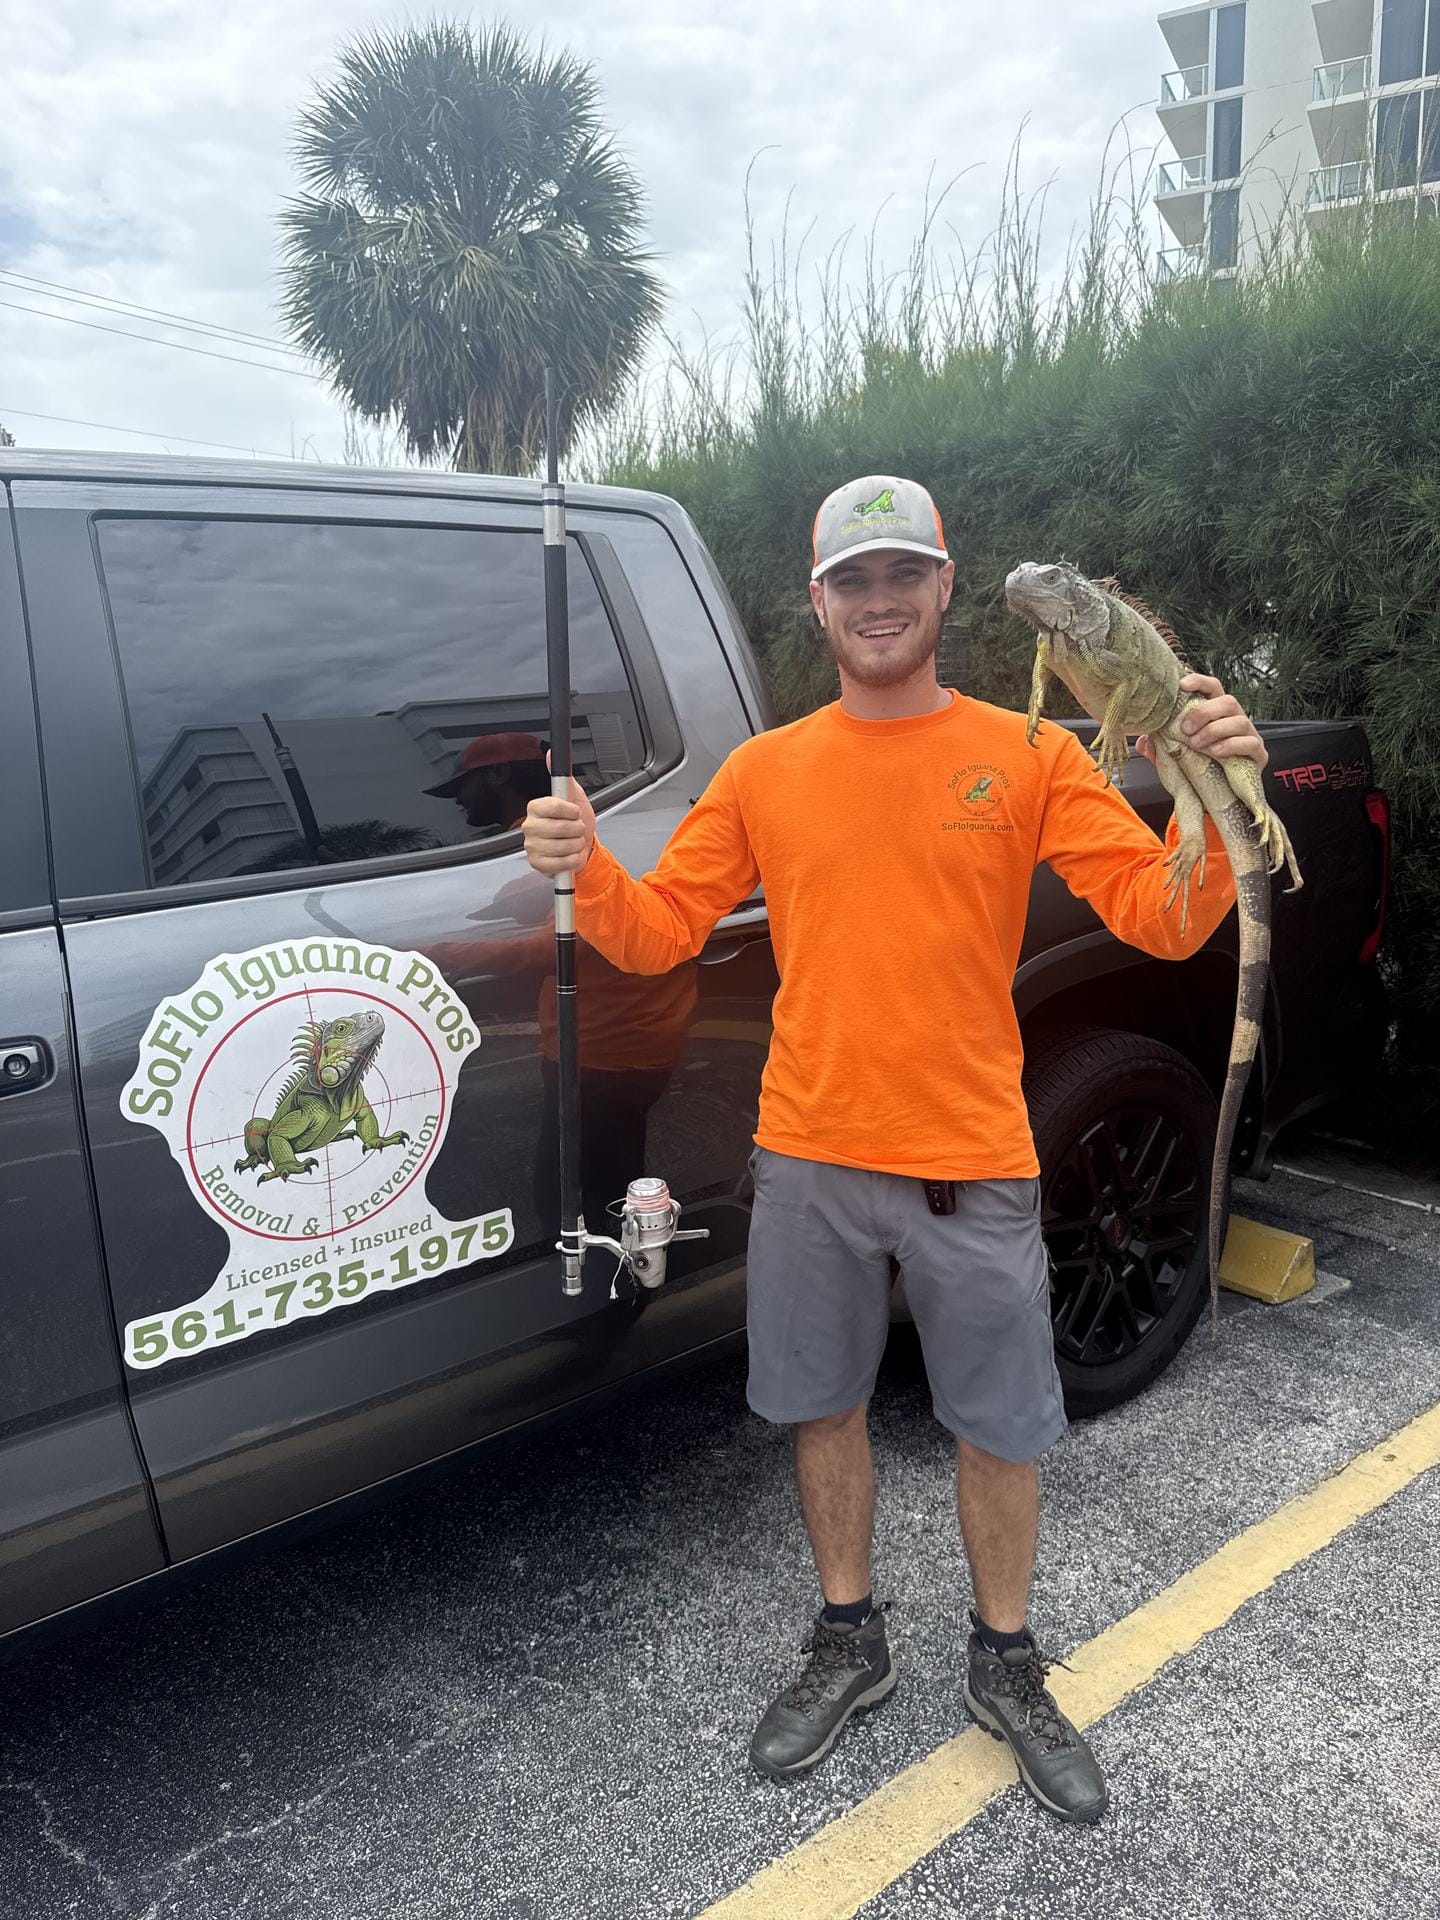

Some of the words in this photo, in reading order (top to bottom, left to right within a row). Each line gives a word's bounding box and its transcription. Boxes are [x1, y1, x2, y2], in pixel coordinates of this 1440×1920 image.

[948, 770, 967, 789] SoFlo
[968, 764, 997, 774] Iguana
[998, 770, 1010, 789] Pros
[1274, 764, 1326, 792] TRD
[942, 822, 1014, 832] SoFloIguana.com
[128, 989, 225, 1118] SoFlo
[213, 943, 391, 1001] Iguana
[395, 958, 475, 1054] Pros
[200, 1164, 294, 1235] Removal
[302, 1217, 321, 1237] &
[342, 1113, 440, 1226] Prevention
[132, 1214, 510, 1364] 561-735-1975
[225, 1246, 329, 1292] Licensed
[351, 1214, 433, 1256] Insured
